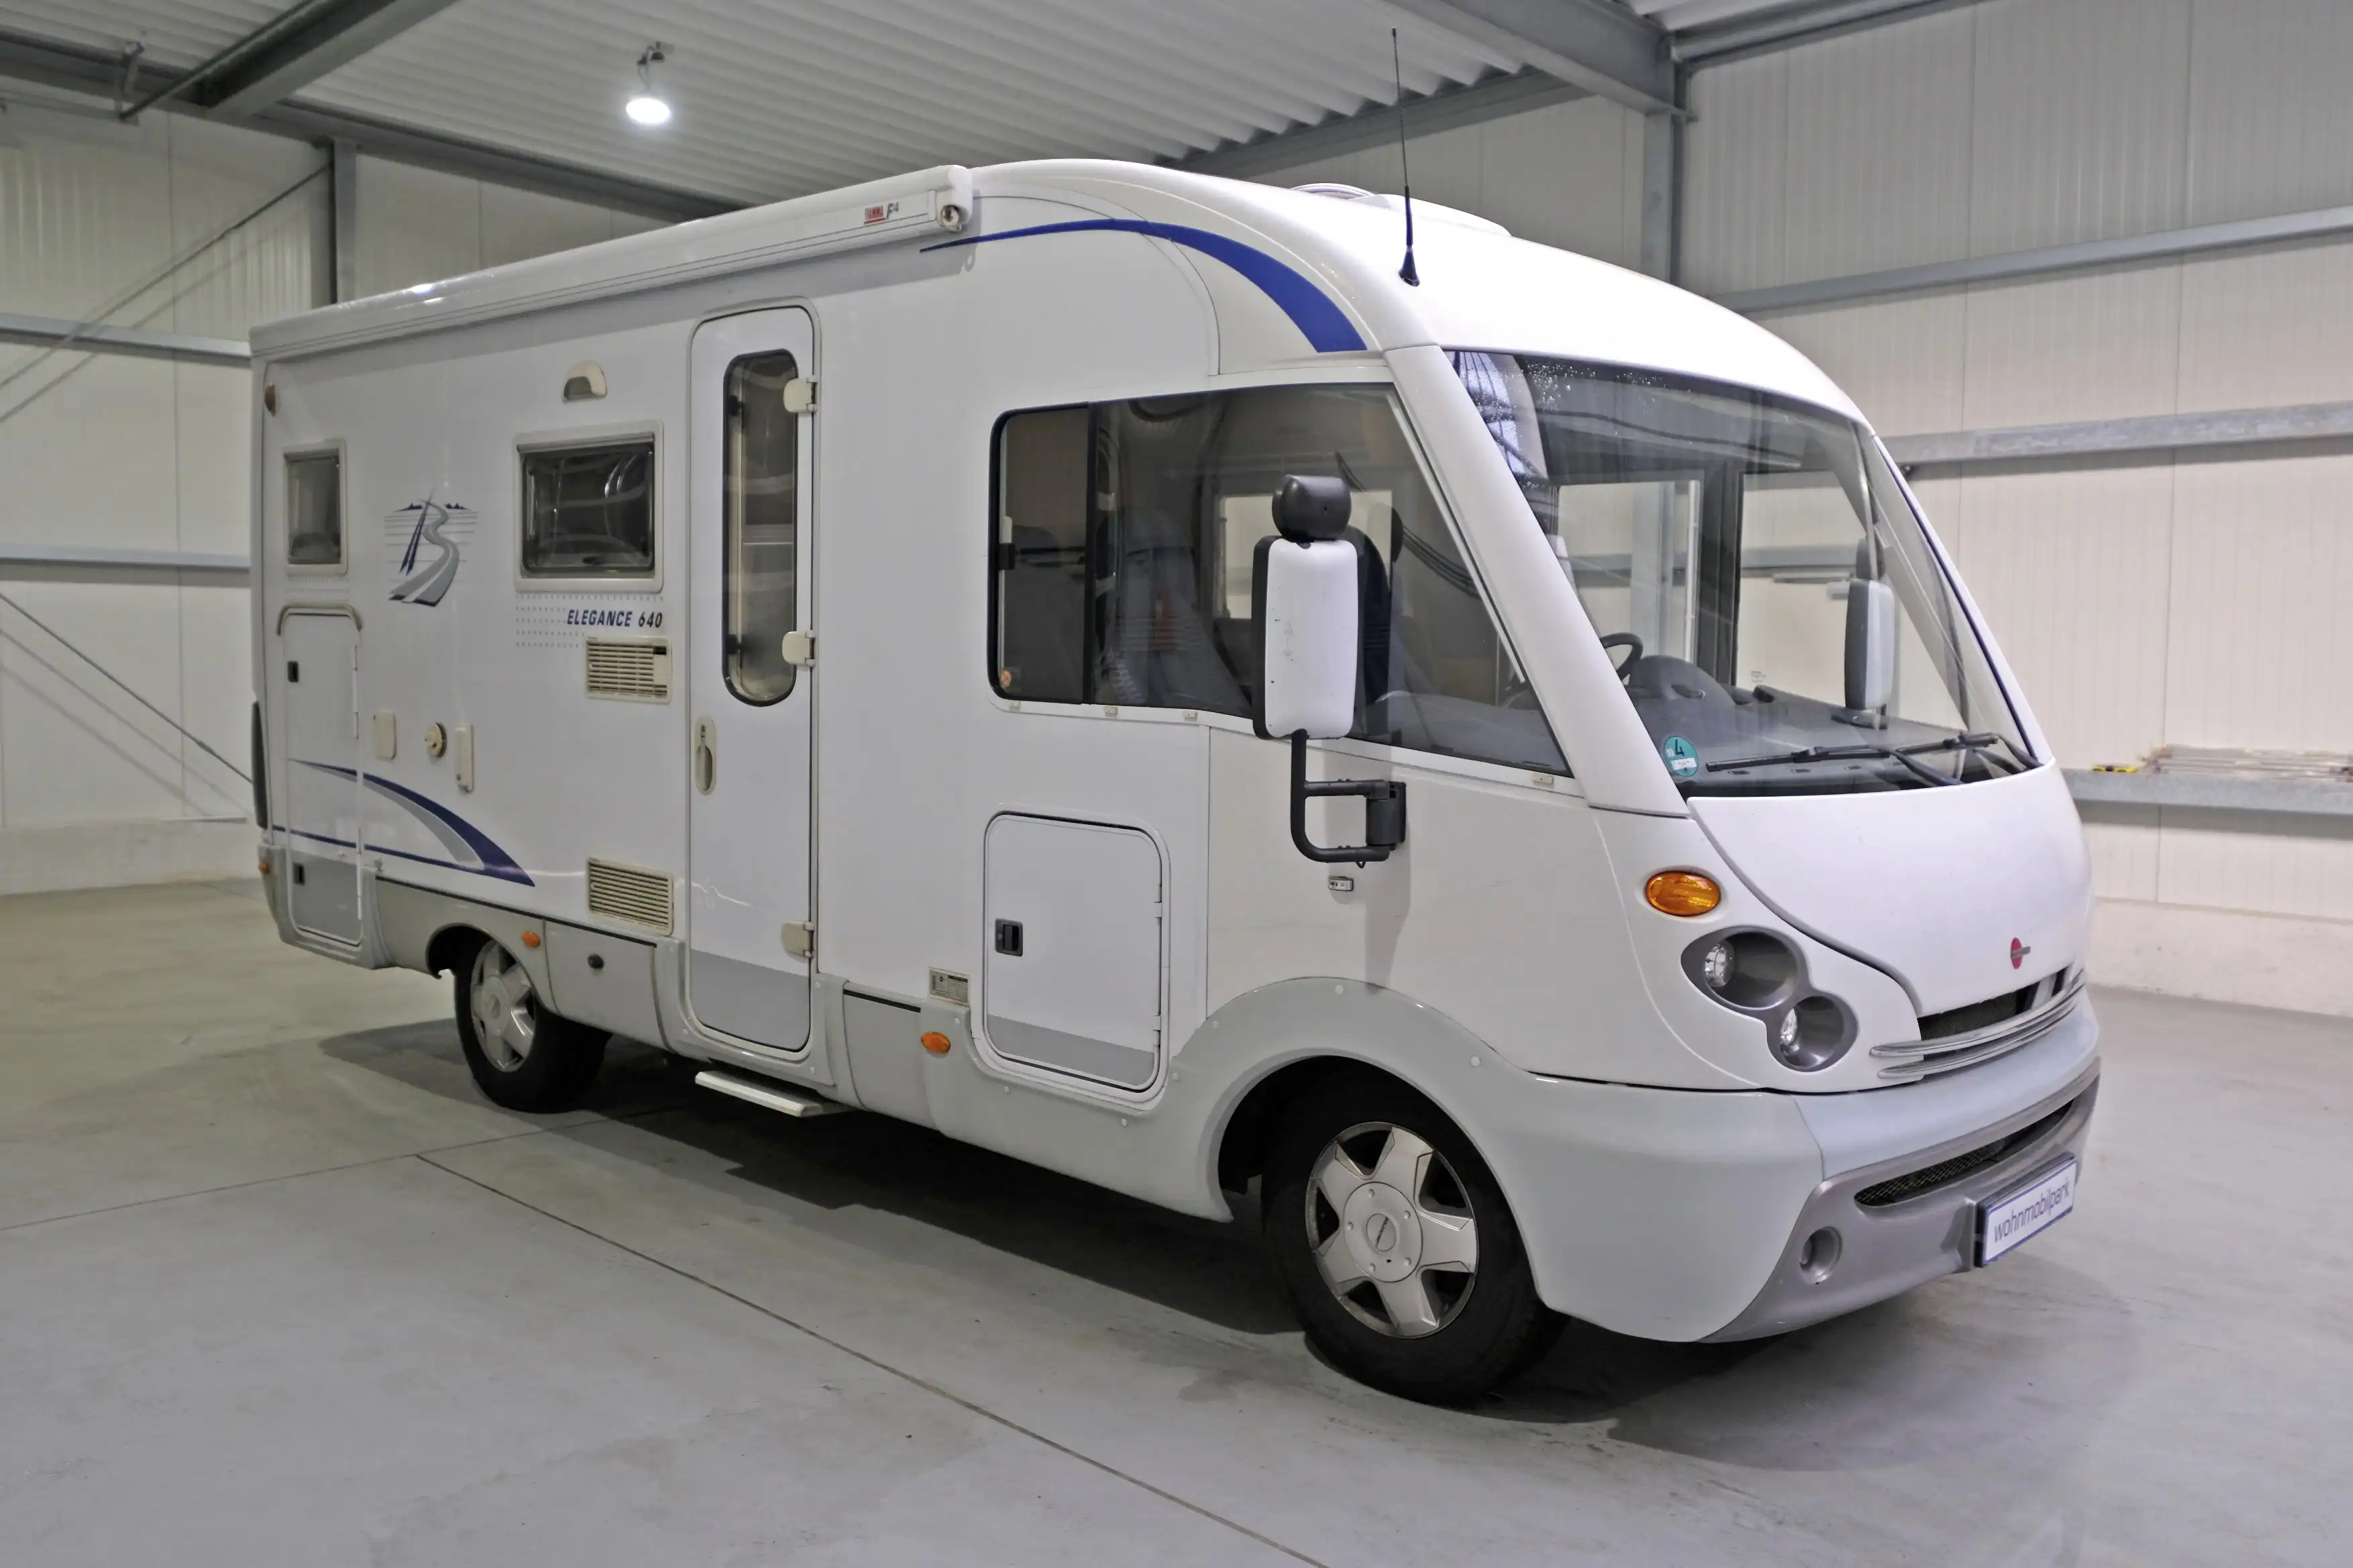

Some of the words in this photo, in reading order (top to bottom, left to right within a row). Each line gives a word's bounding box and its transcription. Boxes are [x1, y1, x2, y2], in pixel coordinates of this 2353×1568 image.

[567, 609, 633, 626] ELEGANCE
[638, 611, 663, 628] 640
[1675, 739, 1684, 757] 4
[1994, 1178, 2070, 1243] wohnmobilpark
